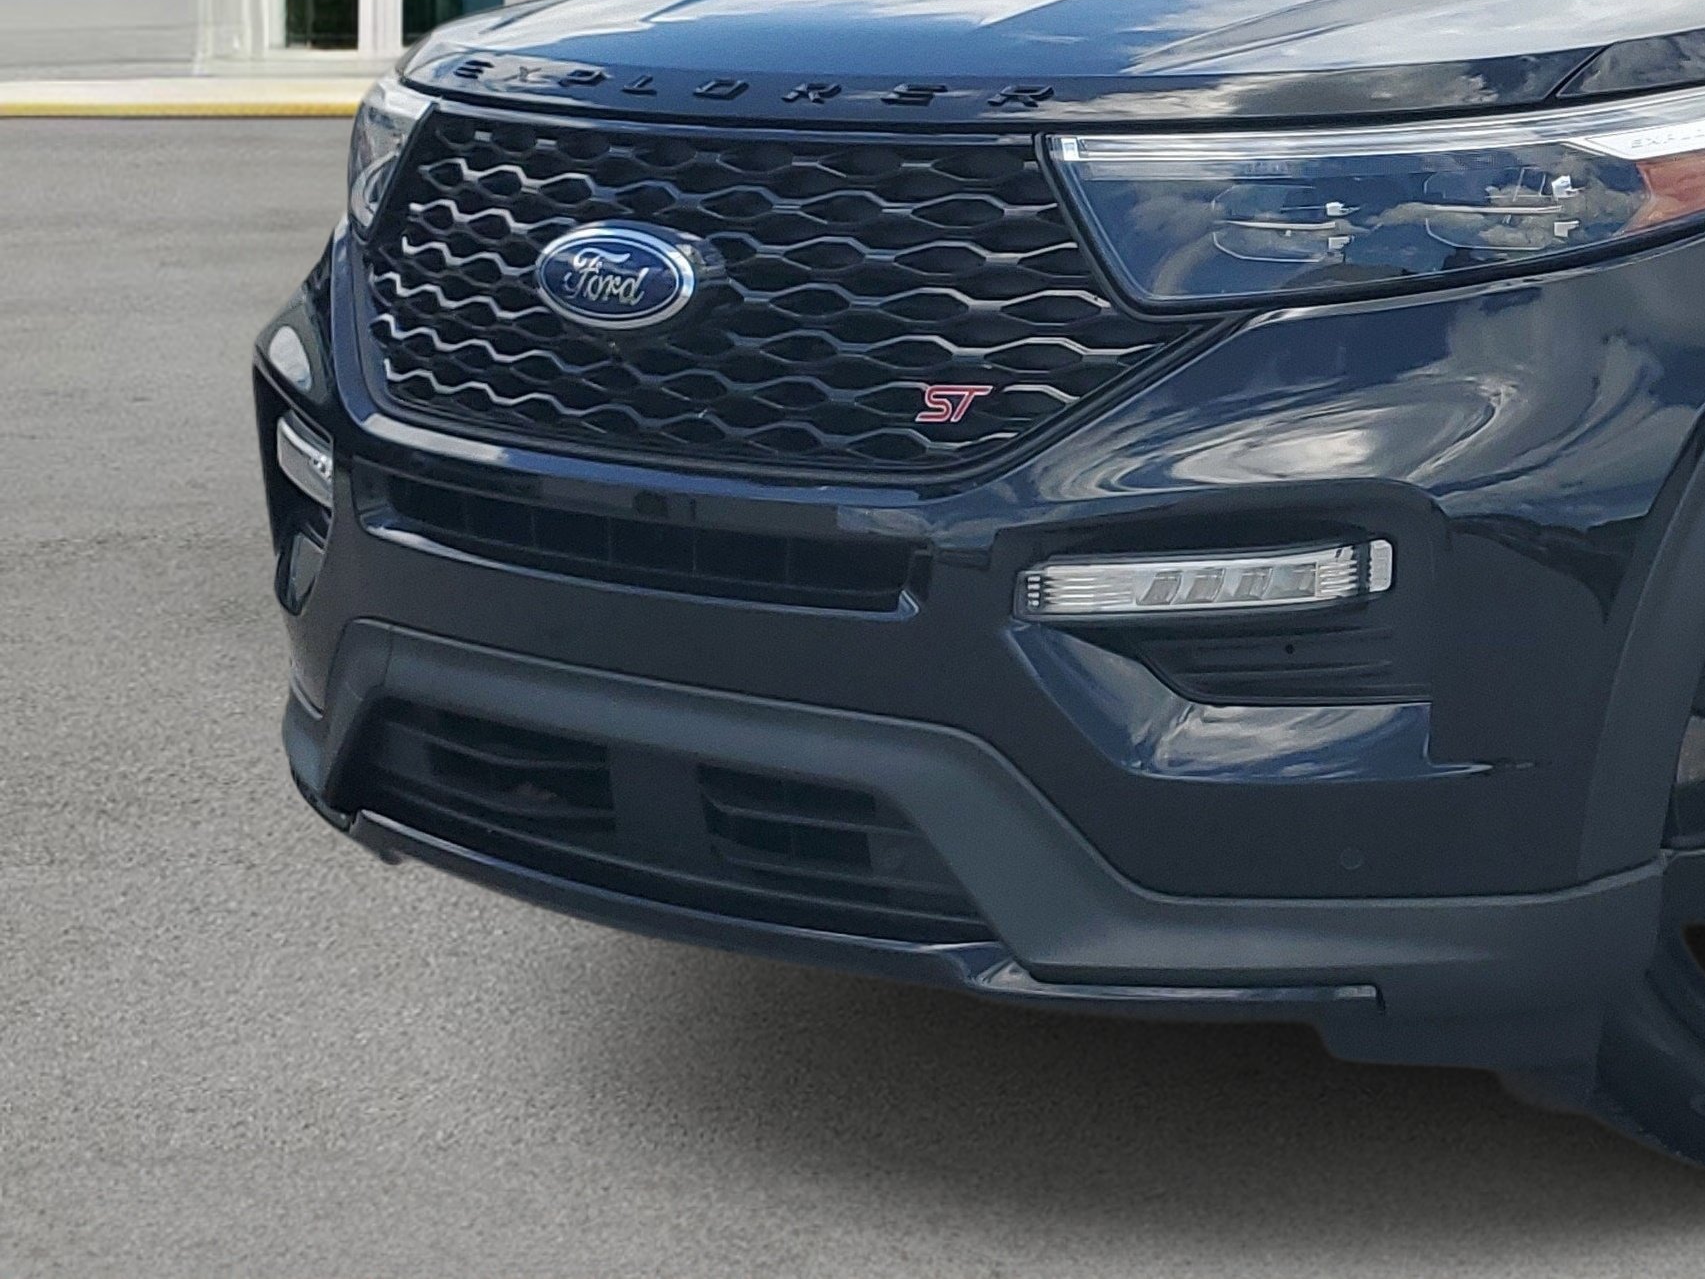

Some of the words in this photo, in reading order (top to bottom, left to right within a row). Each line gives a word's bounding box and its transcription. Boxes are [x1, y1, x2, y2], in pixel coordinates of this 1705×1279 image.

[453, 59, 1056, 108] EXPLORER
[563, 246, 650, 307] Ford
[914, 384, 994, 422] ST
